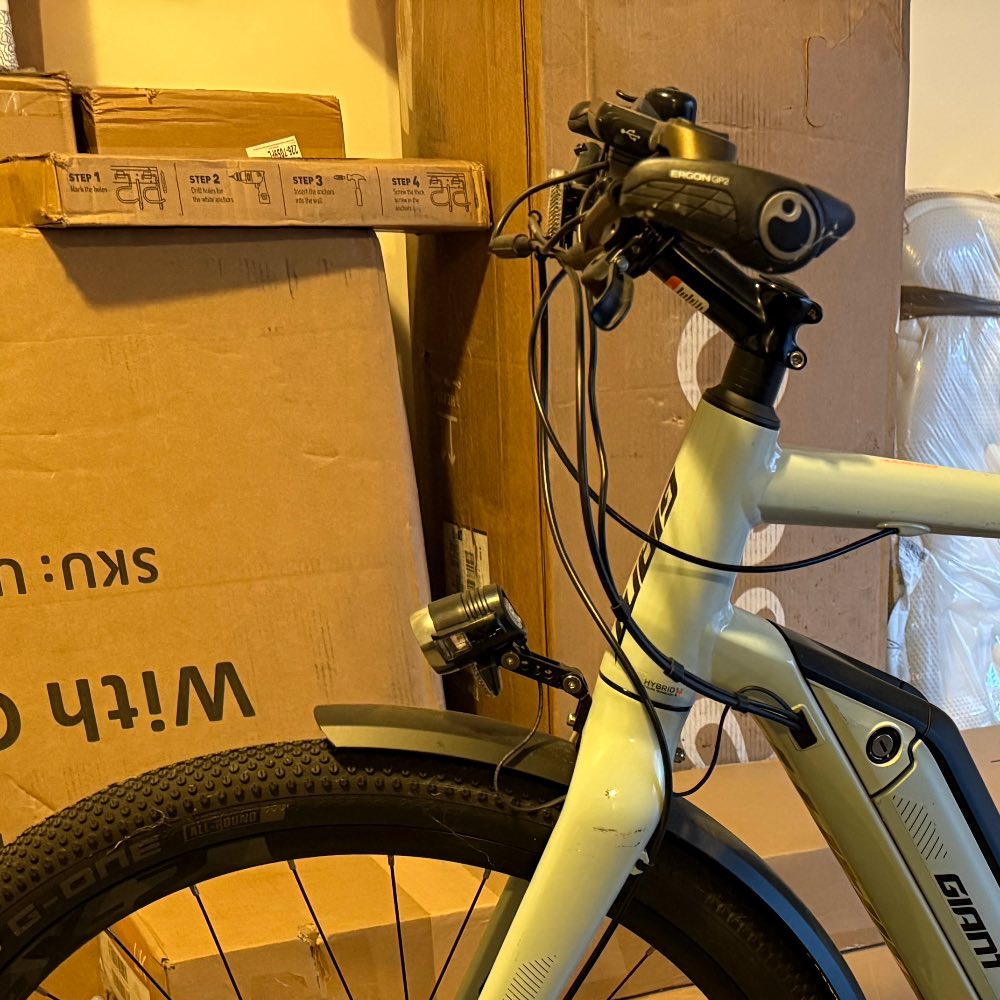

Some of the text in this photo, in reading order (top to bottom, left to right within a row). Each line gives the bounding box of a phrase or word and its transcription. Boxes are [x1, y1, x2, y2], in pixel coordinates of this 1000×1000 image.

[69, 171, 101, 183] STEP 1
[189, 173, 221, 185] STEP 2
[292, 174, 323, 187] STEP 3
[391, 175, 420, 188] STEP 4
[670, 169, 730, 186] ERGON GP2
[41, 546, 159, 591] SKU:
[643, 678, 676, 694] HYBRID
[47, 661, 256, 743] With
[9, 839, 162, 936] G-ONE
